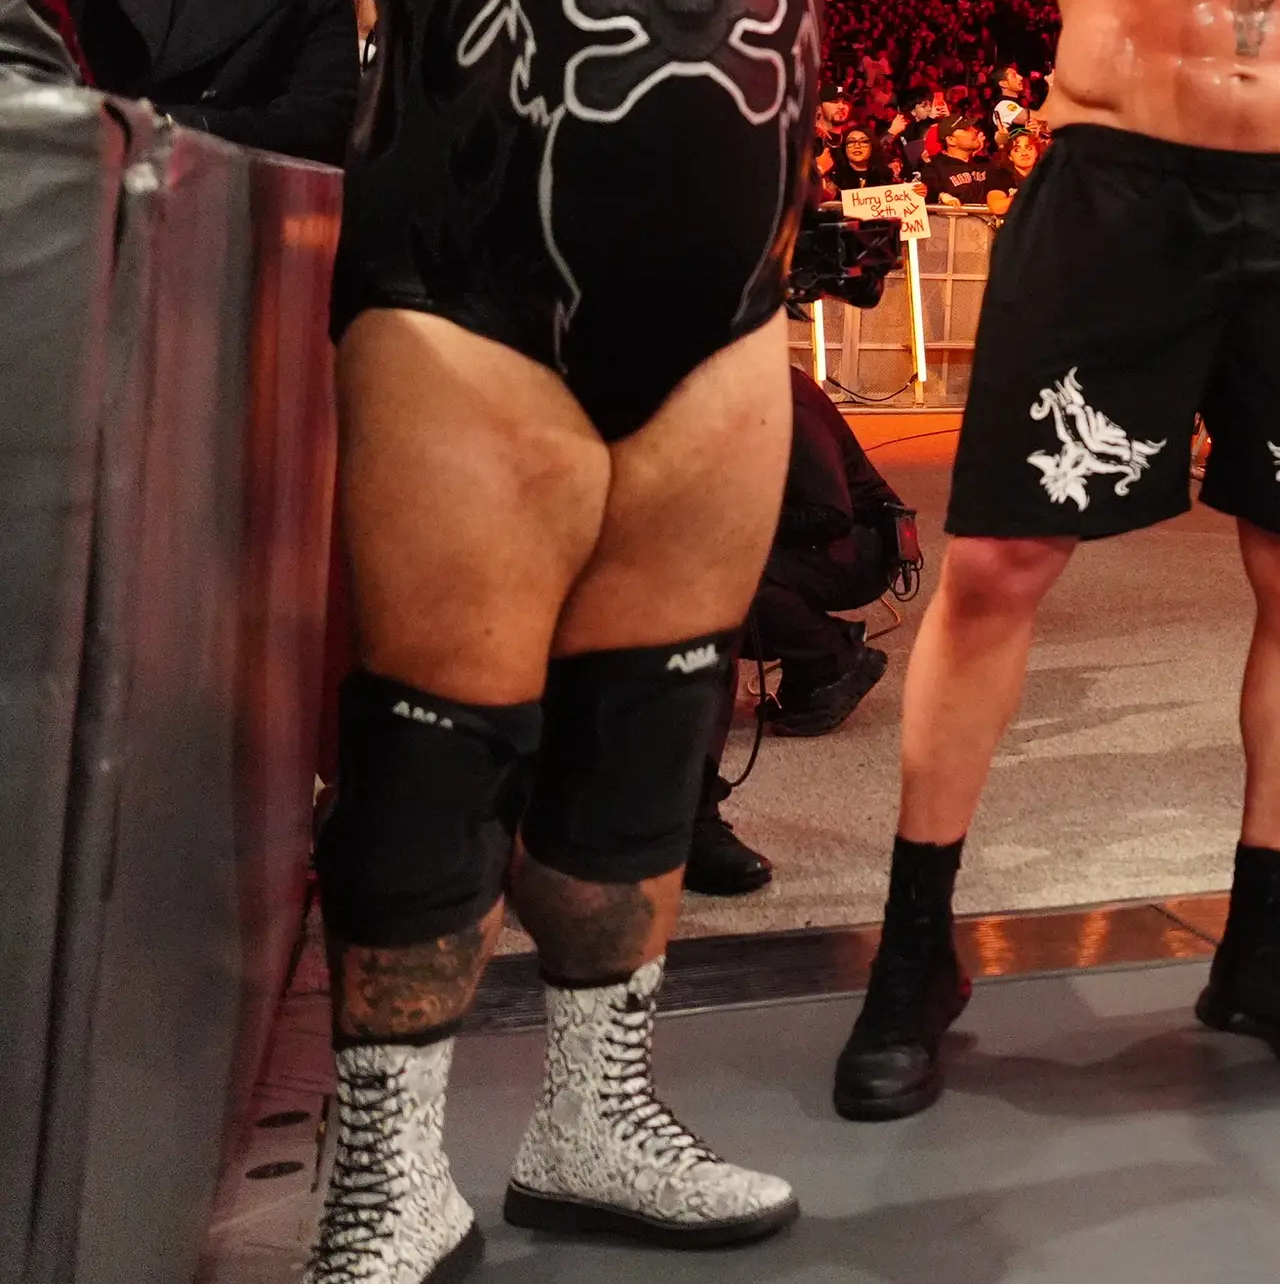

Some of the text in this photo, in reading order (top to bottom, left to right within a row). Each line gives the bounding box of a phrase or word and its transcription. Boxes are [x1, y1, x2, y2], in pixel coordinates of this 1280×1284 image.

[852, 189, 912, 211] Hurry Back
[870, 202, 920, 217] Seth ALL
[900, 219, 925, 233] OWN
